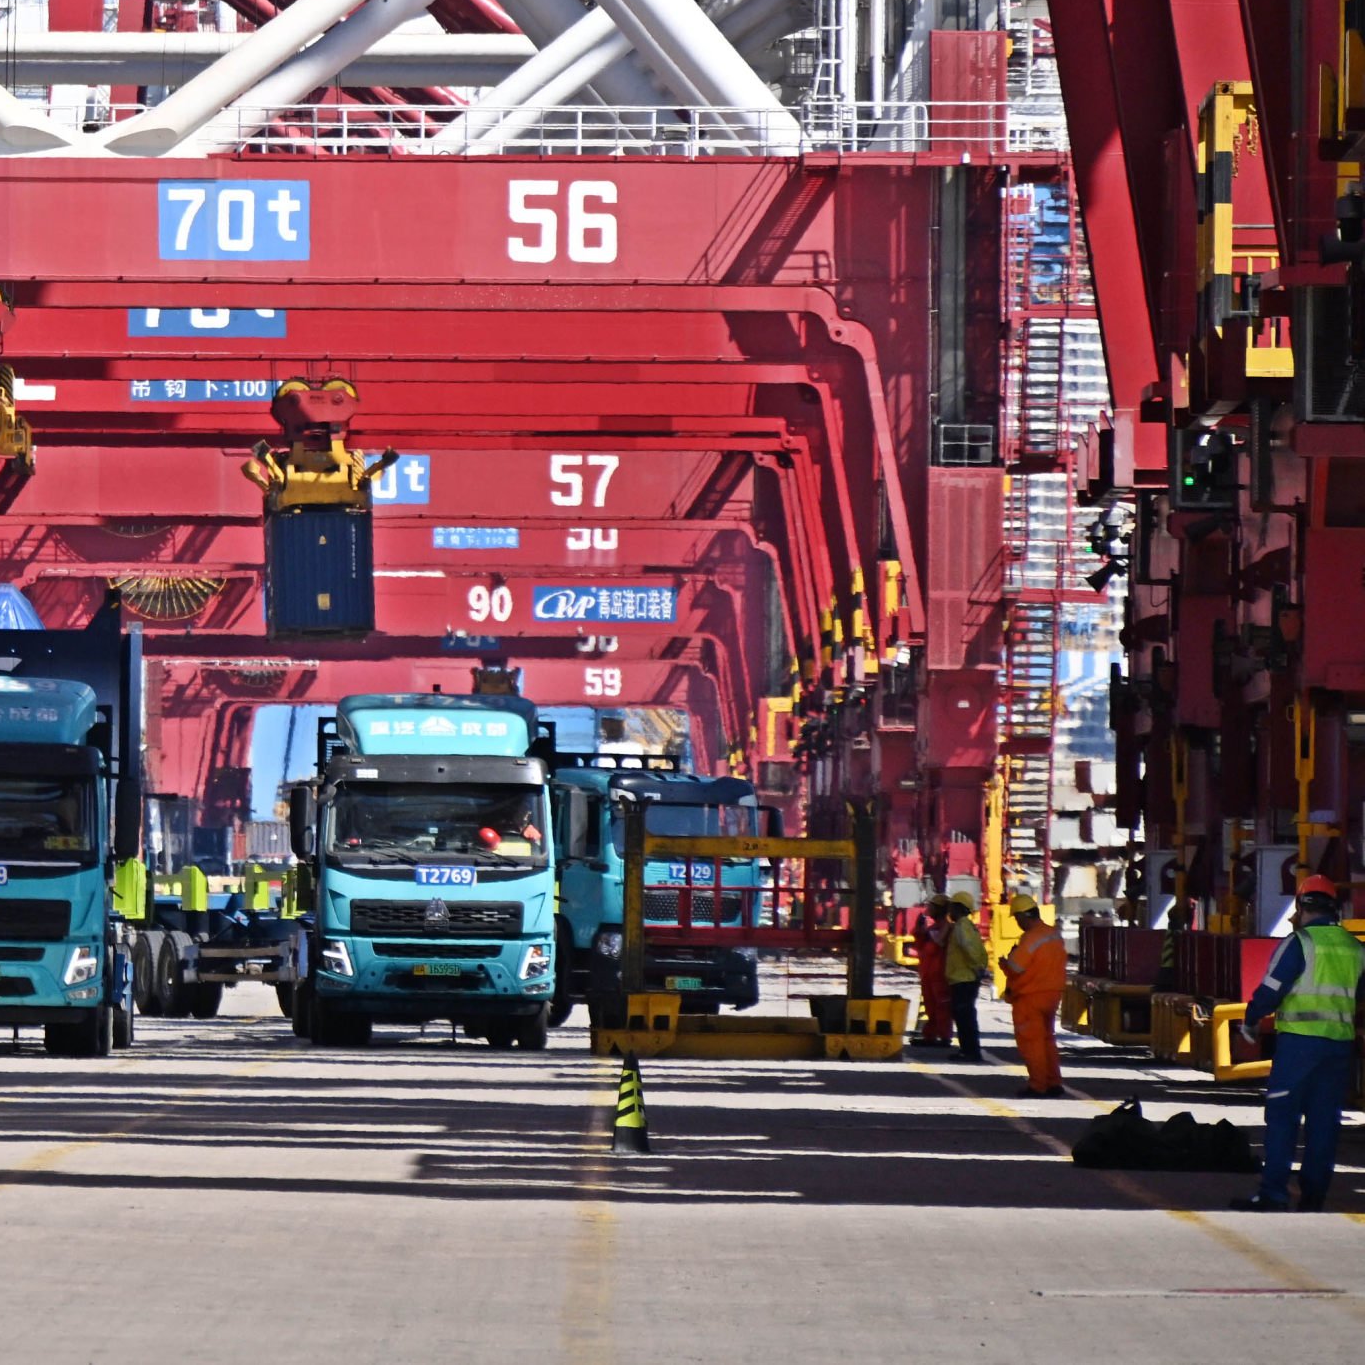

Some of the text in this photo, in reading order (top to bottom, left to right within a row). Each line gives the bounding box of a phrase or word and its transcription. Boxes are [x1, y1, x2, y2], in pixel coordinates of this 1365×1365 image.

[507, 180, 618, 263] 56
[550, 454, 620, 508] 57
[468, 585, 514, 622] 90
[584, 667, 622, 696] 59
[417, 868, 472, 884] T2769
